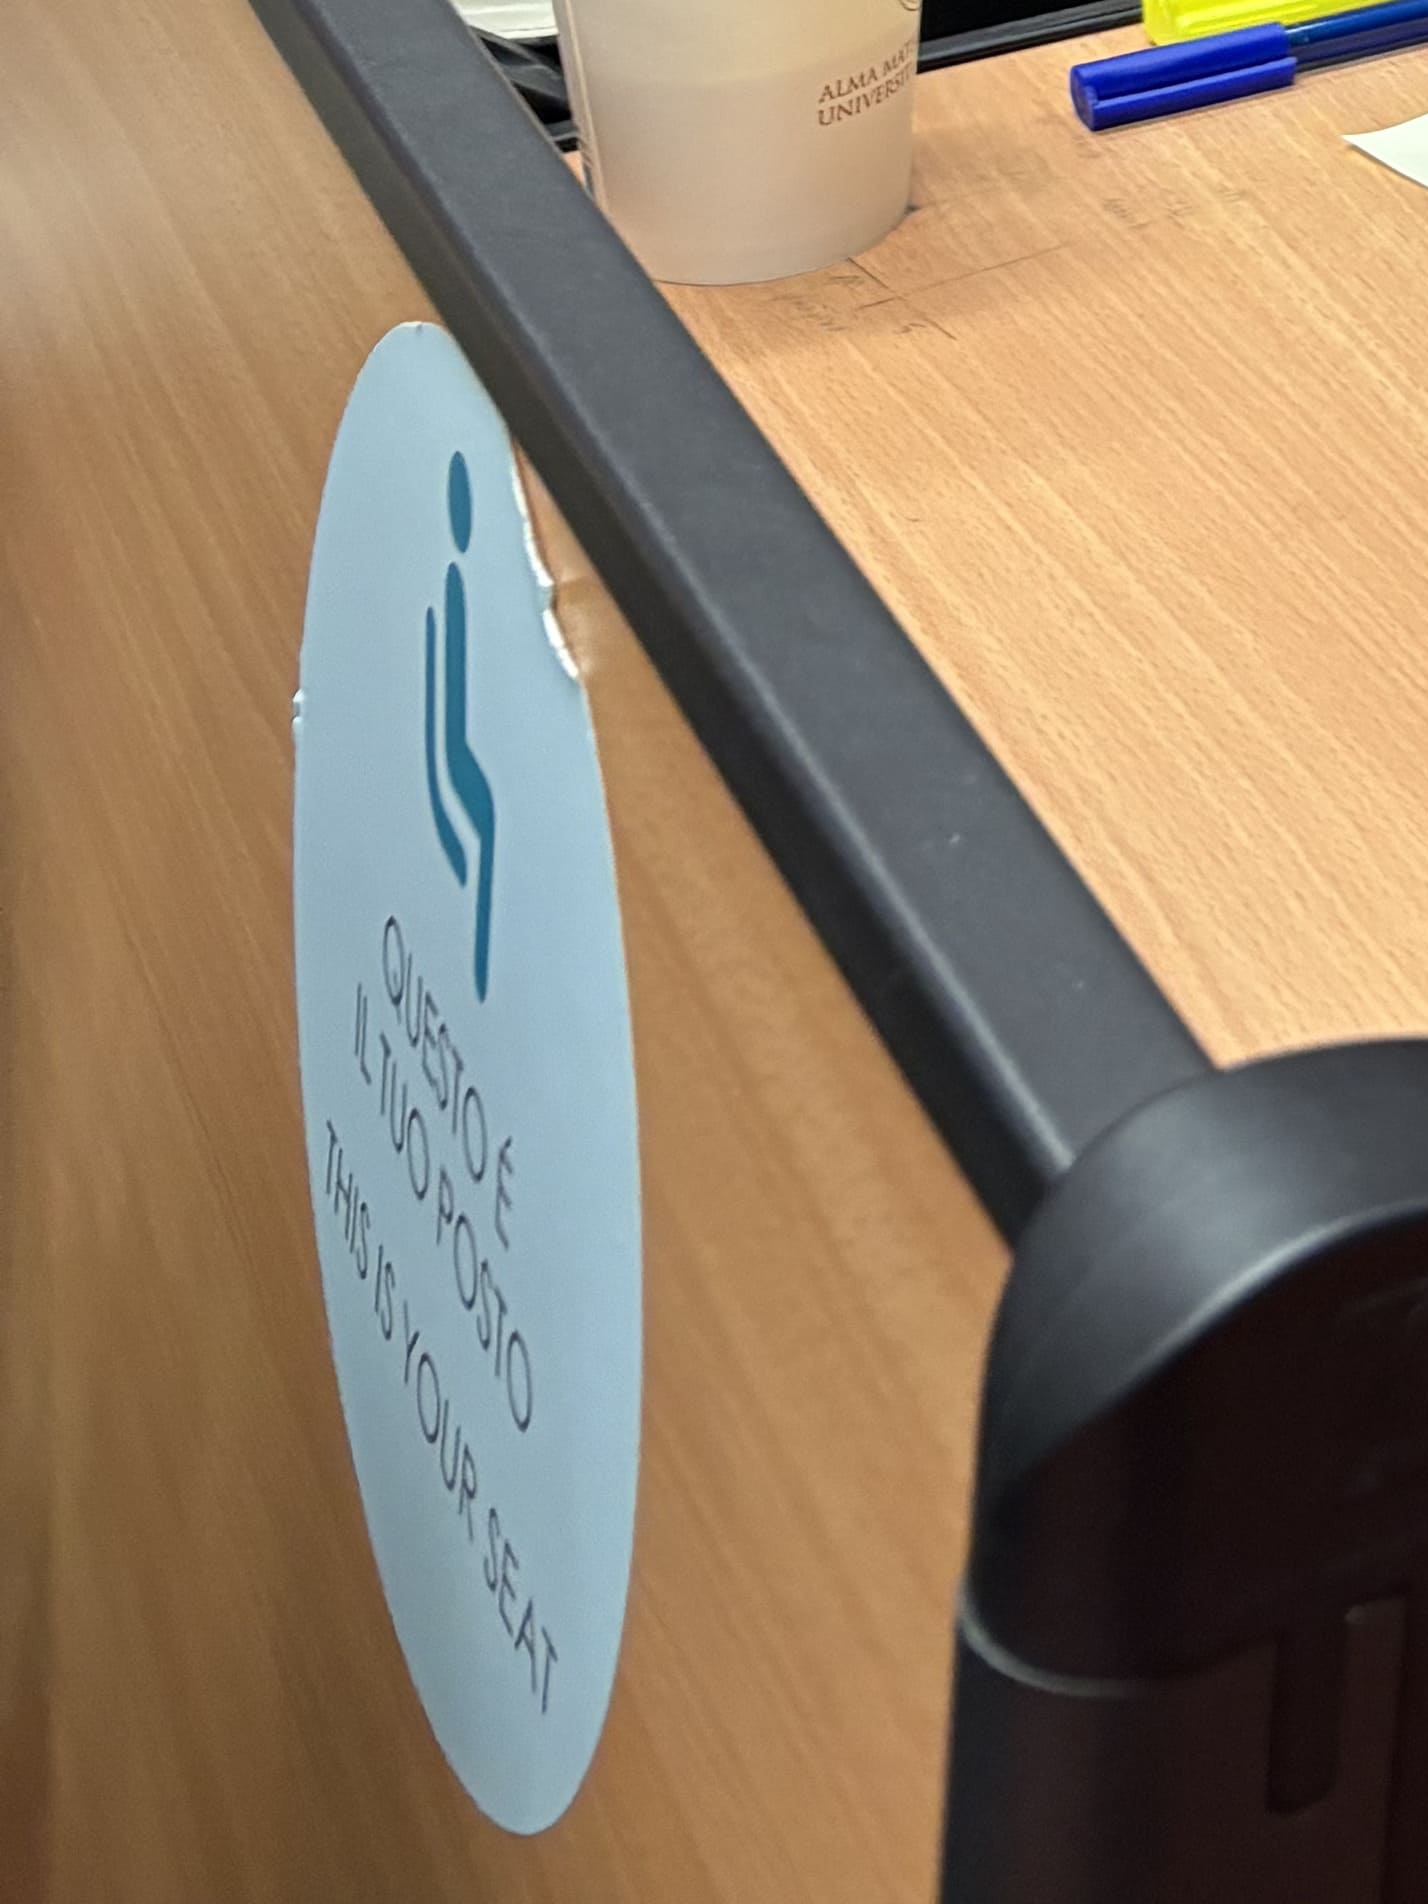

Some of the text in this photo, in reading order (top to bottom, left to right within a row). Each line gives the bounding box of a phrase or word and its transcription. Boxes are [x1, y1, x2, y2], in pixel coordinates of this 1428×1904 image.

[818, 66, 878, 104] ALMA
[354, 981, 533, 1434] IL TUO POSTO
[383, 914, 488, 1184] QUESTO
[325, 1118, 559, 1715] THIS IS YOUR SEAT
